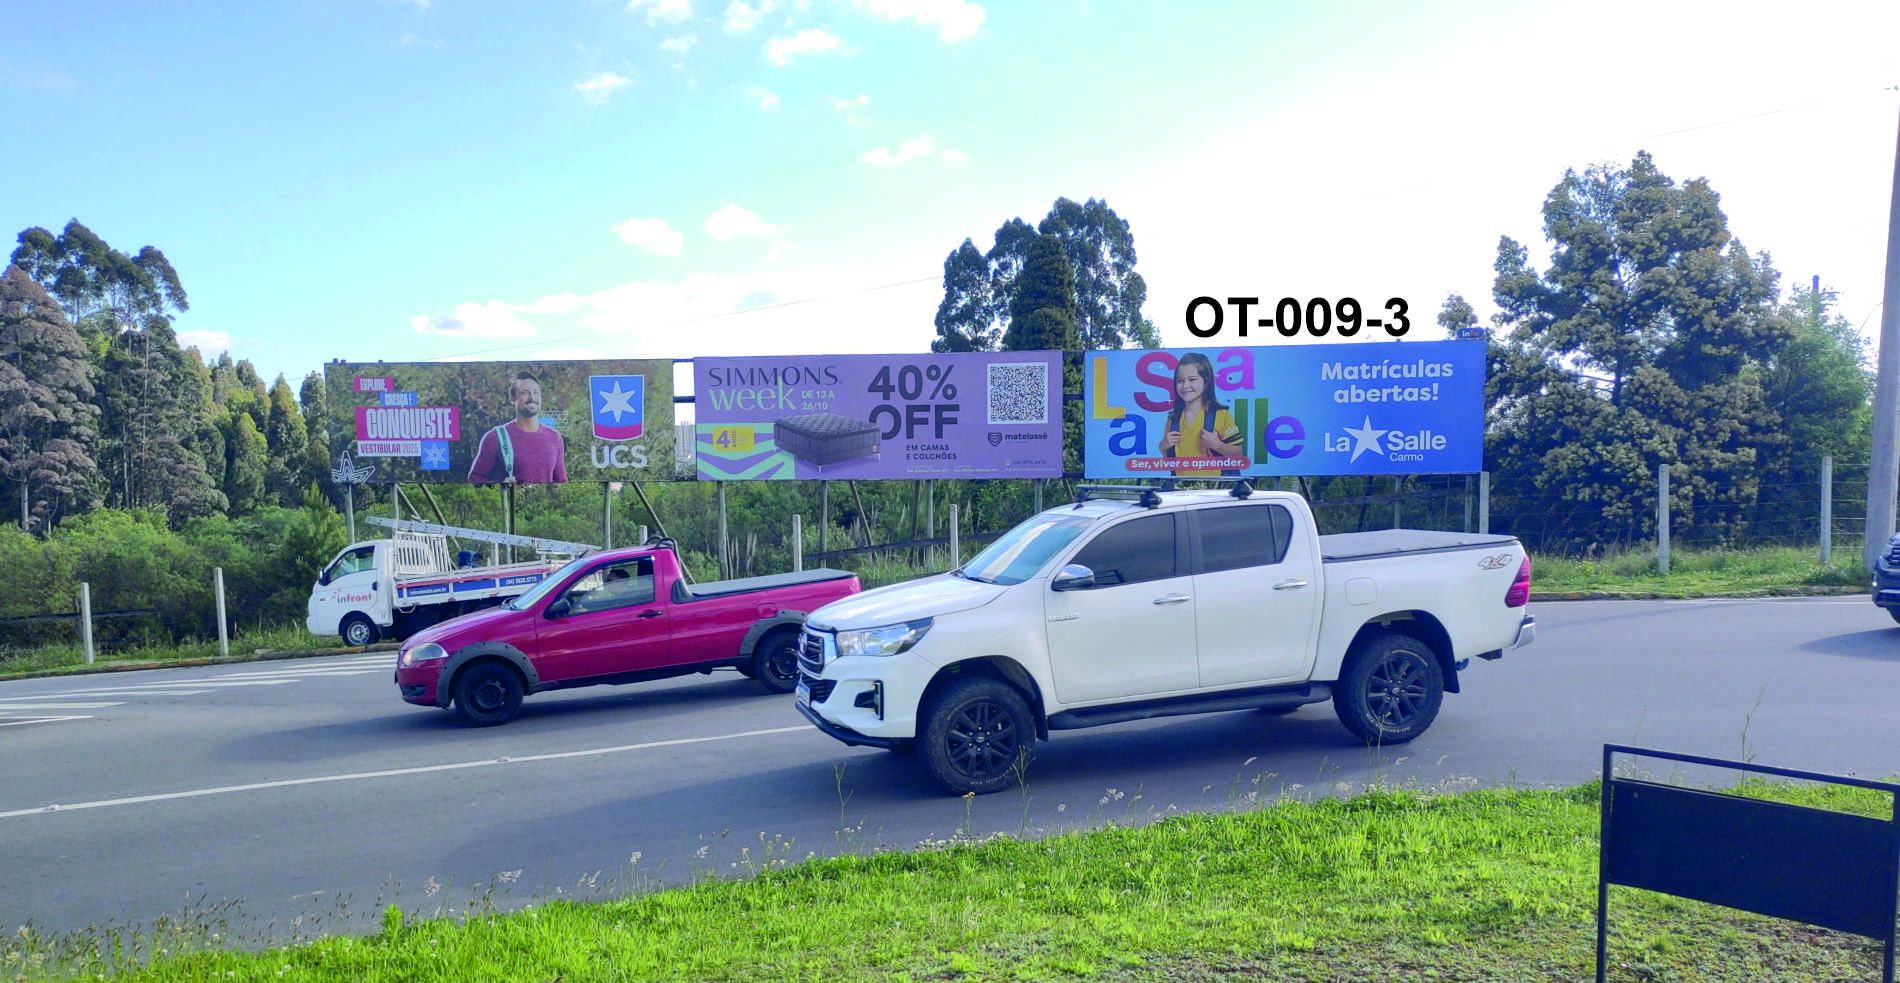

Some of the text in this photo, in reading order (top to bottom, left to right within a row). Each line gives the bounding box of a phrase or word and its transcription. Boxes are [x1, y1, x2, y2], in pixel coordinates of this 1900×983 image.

[1321, 359, 1454, 381] Matrículas
[867, 364, 958, 401] 40%
[709, 376, 797, 410] week
[801, 390, 814, 399] DE
[829, 390, 835, 399] A
[1334, 383, 1439, 403] abertas!
[366, 408, 453, 439] CONQUISTE
[868, 404, 961, 441] OFF
[360, 443, 400, 454] VESTIBULAR
[716, 430, 730, 448] 4
[920, 443, 950, 451] CAMAS
[1324, 430, 1447, 452] La Salle
[591, 445, 648, 468] UCS
[913, 452, 958, 461] COLCHÕES
[1131, 457, 1245, 470] Ser, viver e aprender.
[1389, 452, 1424, 462] Carmo
[337, 593, 372, 604] infront
